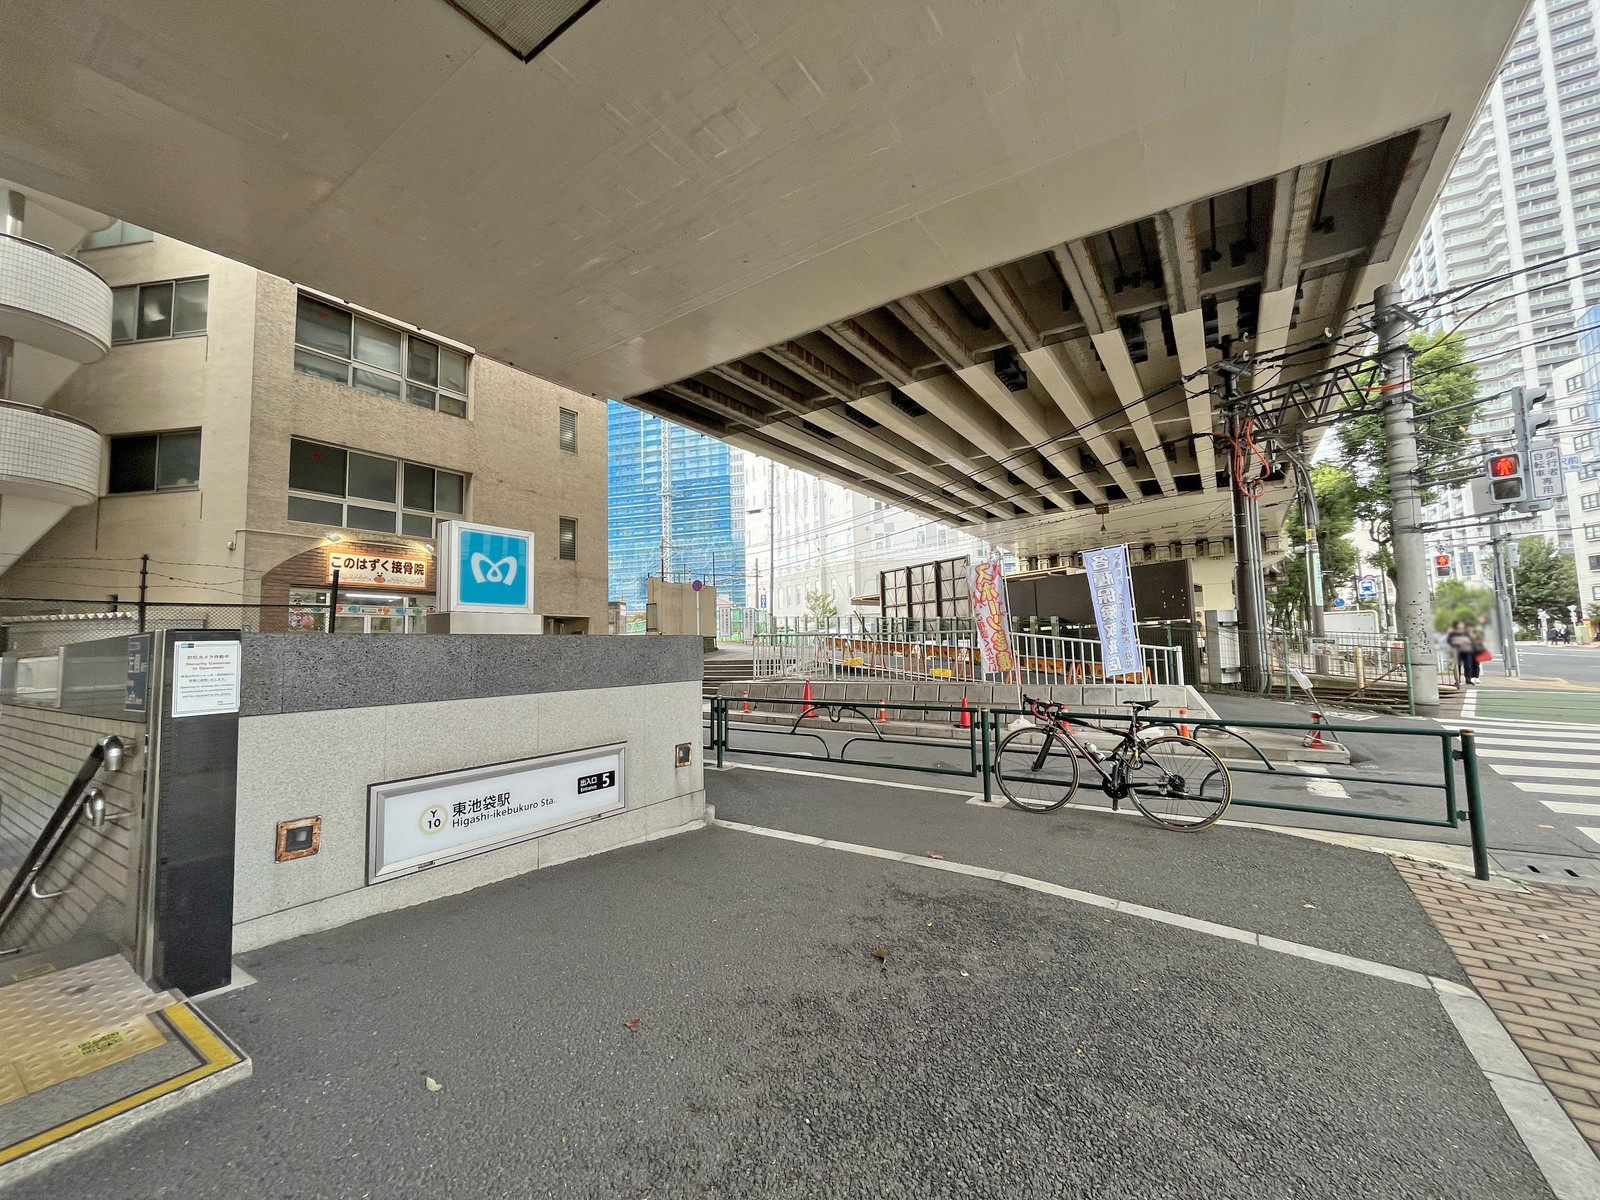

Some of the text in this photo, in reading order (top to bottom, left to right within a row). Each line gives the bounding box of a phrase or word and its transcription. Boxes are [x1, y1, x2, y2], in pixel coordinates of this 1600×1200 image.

[1533, 453, 1545, 477] 自転車
[1545, 451, 1558, 476] 歩行者
[1543, 477, 1554, 494] 専用
[331, 556, 425, 576] このはずく接骨院
[580, 776, 598, 787] 出入口
[602, 772, 610, 787] 5
[580, 784, 598, 793] Entrance
[452, 792, 511, 818] 東池袋駅
[452, 796, 556, 828] Higashi-ikebukuro Sta.
[430, 809, 438, 819] Y
[427, 818, 441, 829] 10
